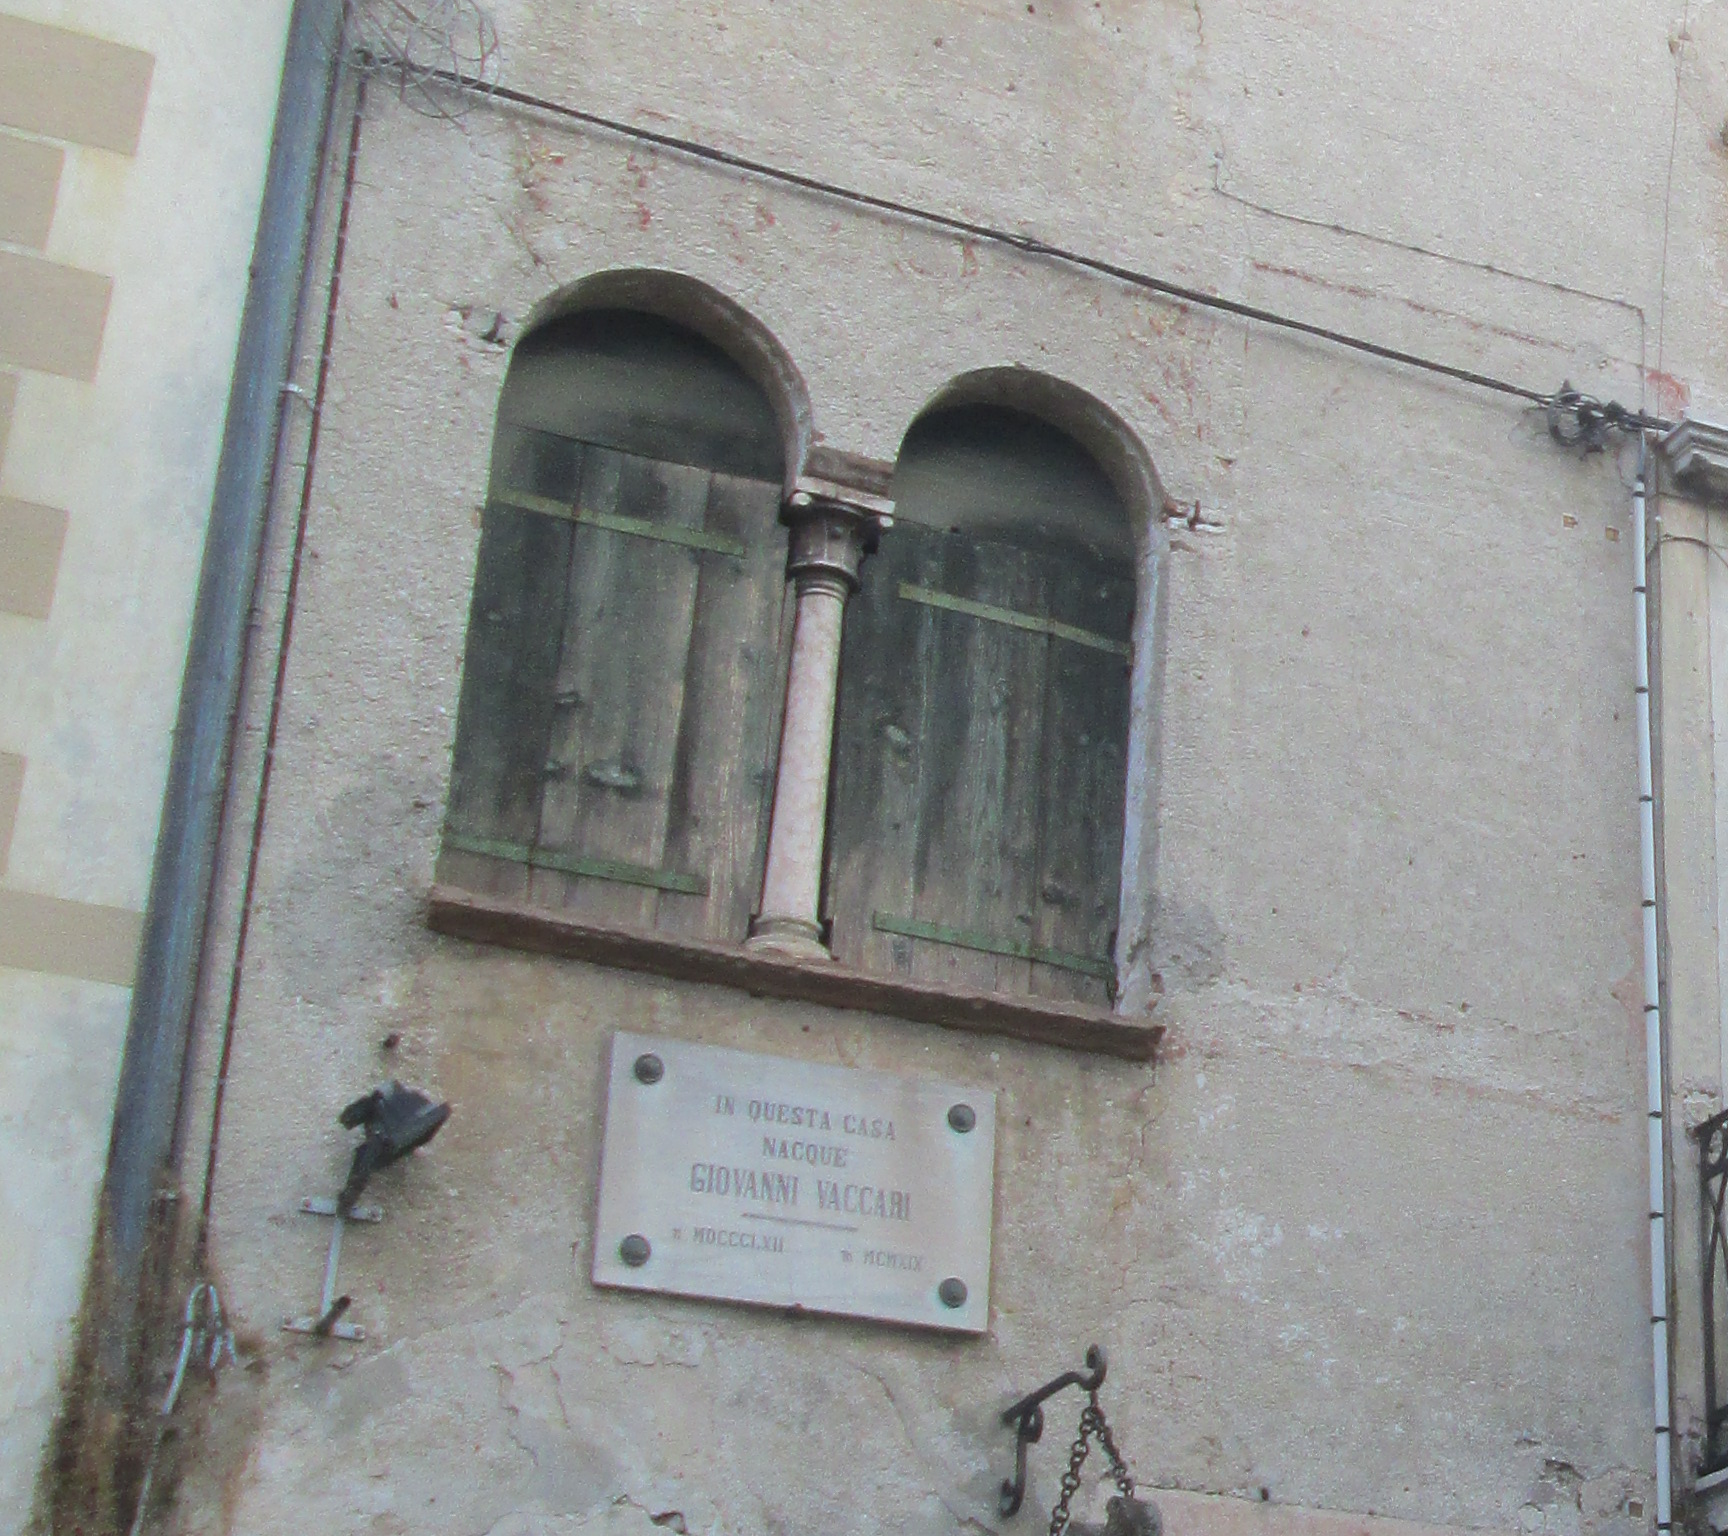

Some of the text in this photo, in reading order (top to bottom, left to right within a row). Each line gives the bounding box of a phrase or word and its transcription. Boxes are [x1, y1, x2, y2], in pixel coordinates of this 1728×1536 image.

[714, 1094, 897, 1142] IN QUESTA CASA
[762, 1136, 849, 1168] NACQUE
[689, 1162, 912, 1222] GIOVANNI VACCARI
